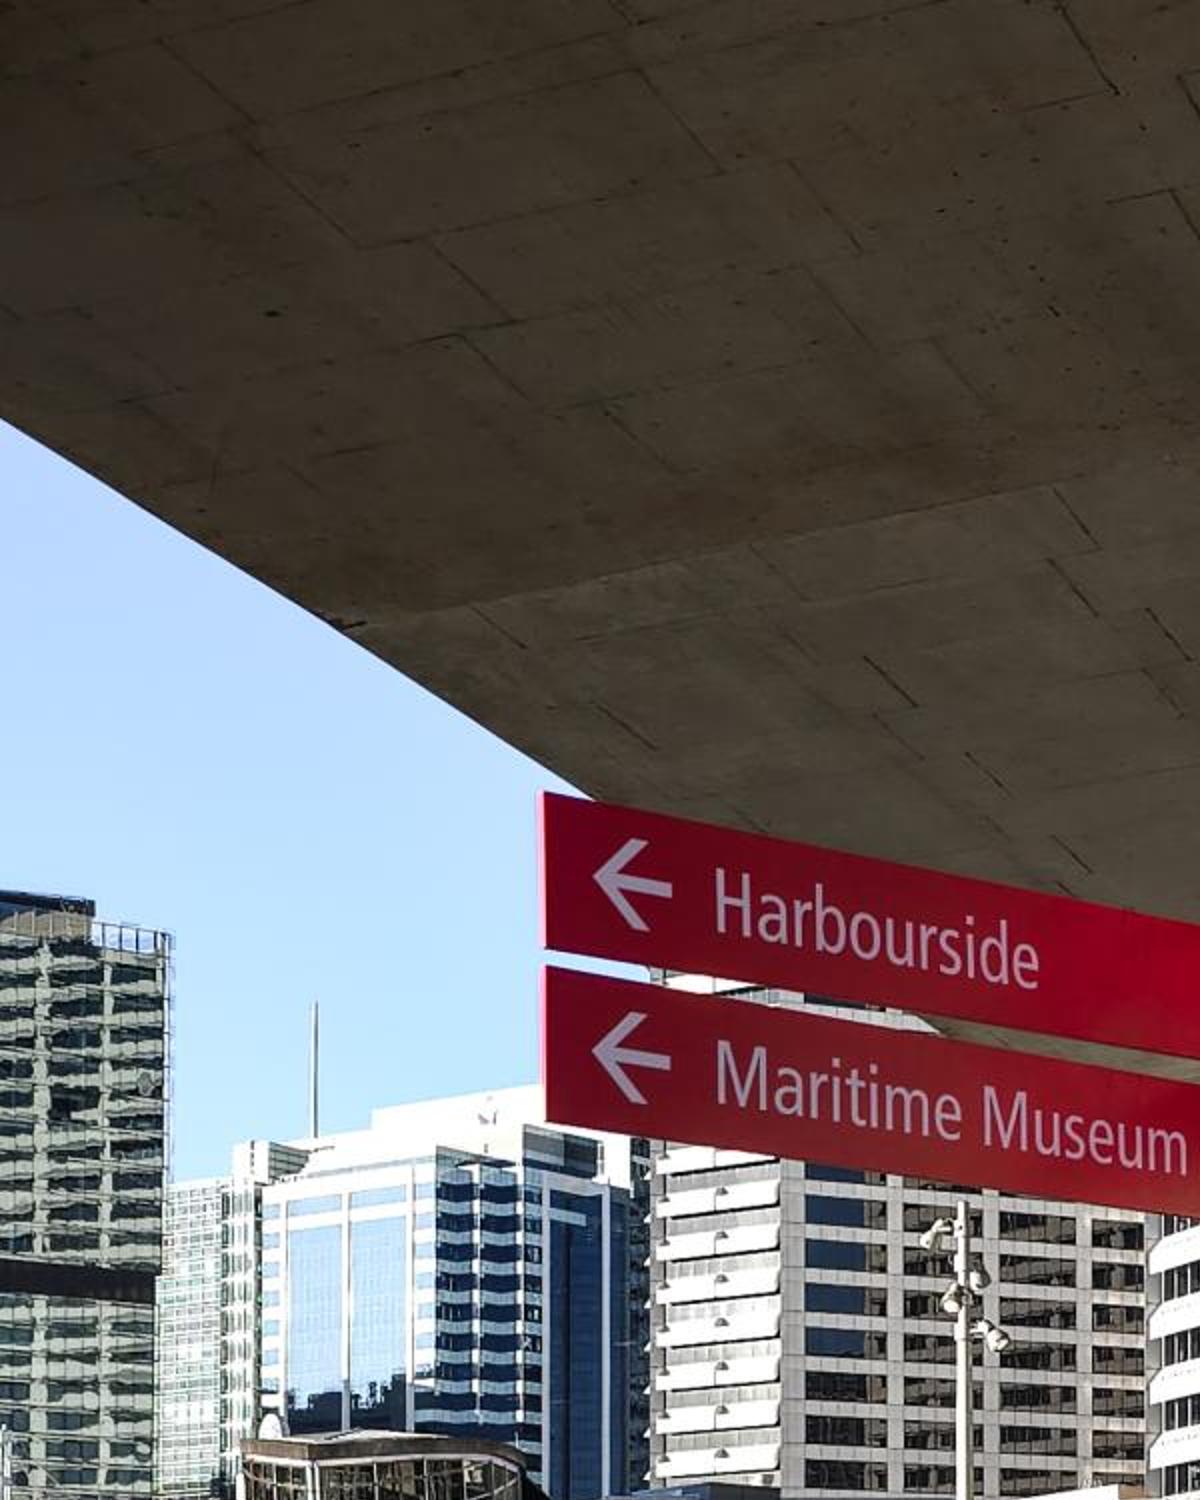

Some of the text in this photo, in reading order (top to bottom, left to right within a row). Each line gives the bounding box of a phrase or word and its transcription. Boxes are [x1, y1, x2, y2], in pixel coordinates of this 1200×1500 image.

[714, 867, 1040, 990] Harbourside
[716, 1038, 1188, 1178] Maritime Museum
